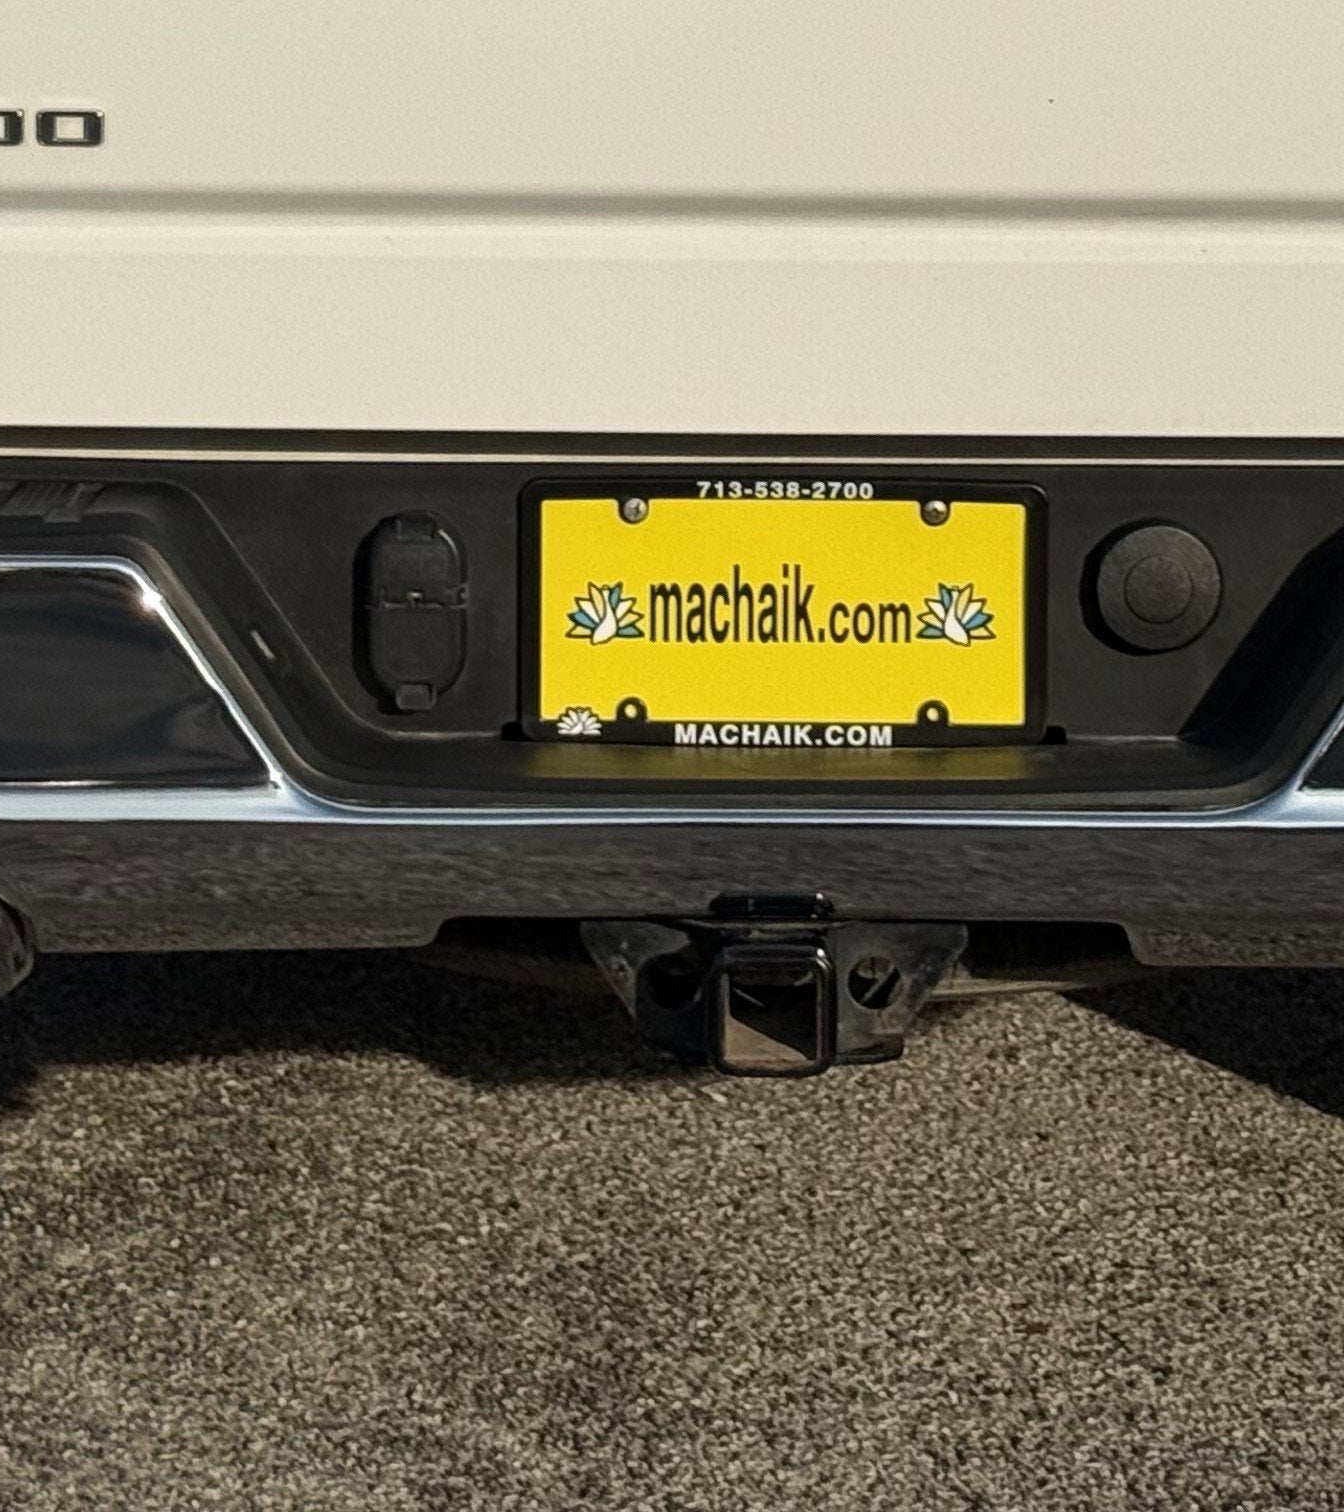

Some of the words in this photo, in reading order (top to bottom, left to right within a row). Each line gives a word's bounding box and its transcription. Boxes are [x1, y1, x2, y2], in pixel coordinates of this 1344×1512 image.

[695, 480, 875, 500] 713-538-2700
[649, 563, 913, 645] machaik.com
[673, 723, 894, 748] MACHAIK.COM
